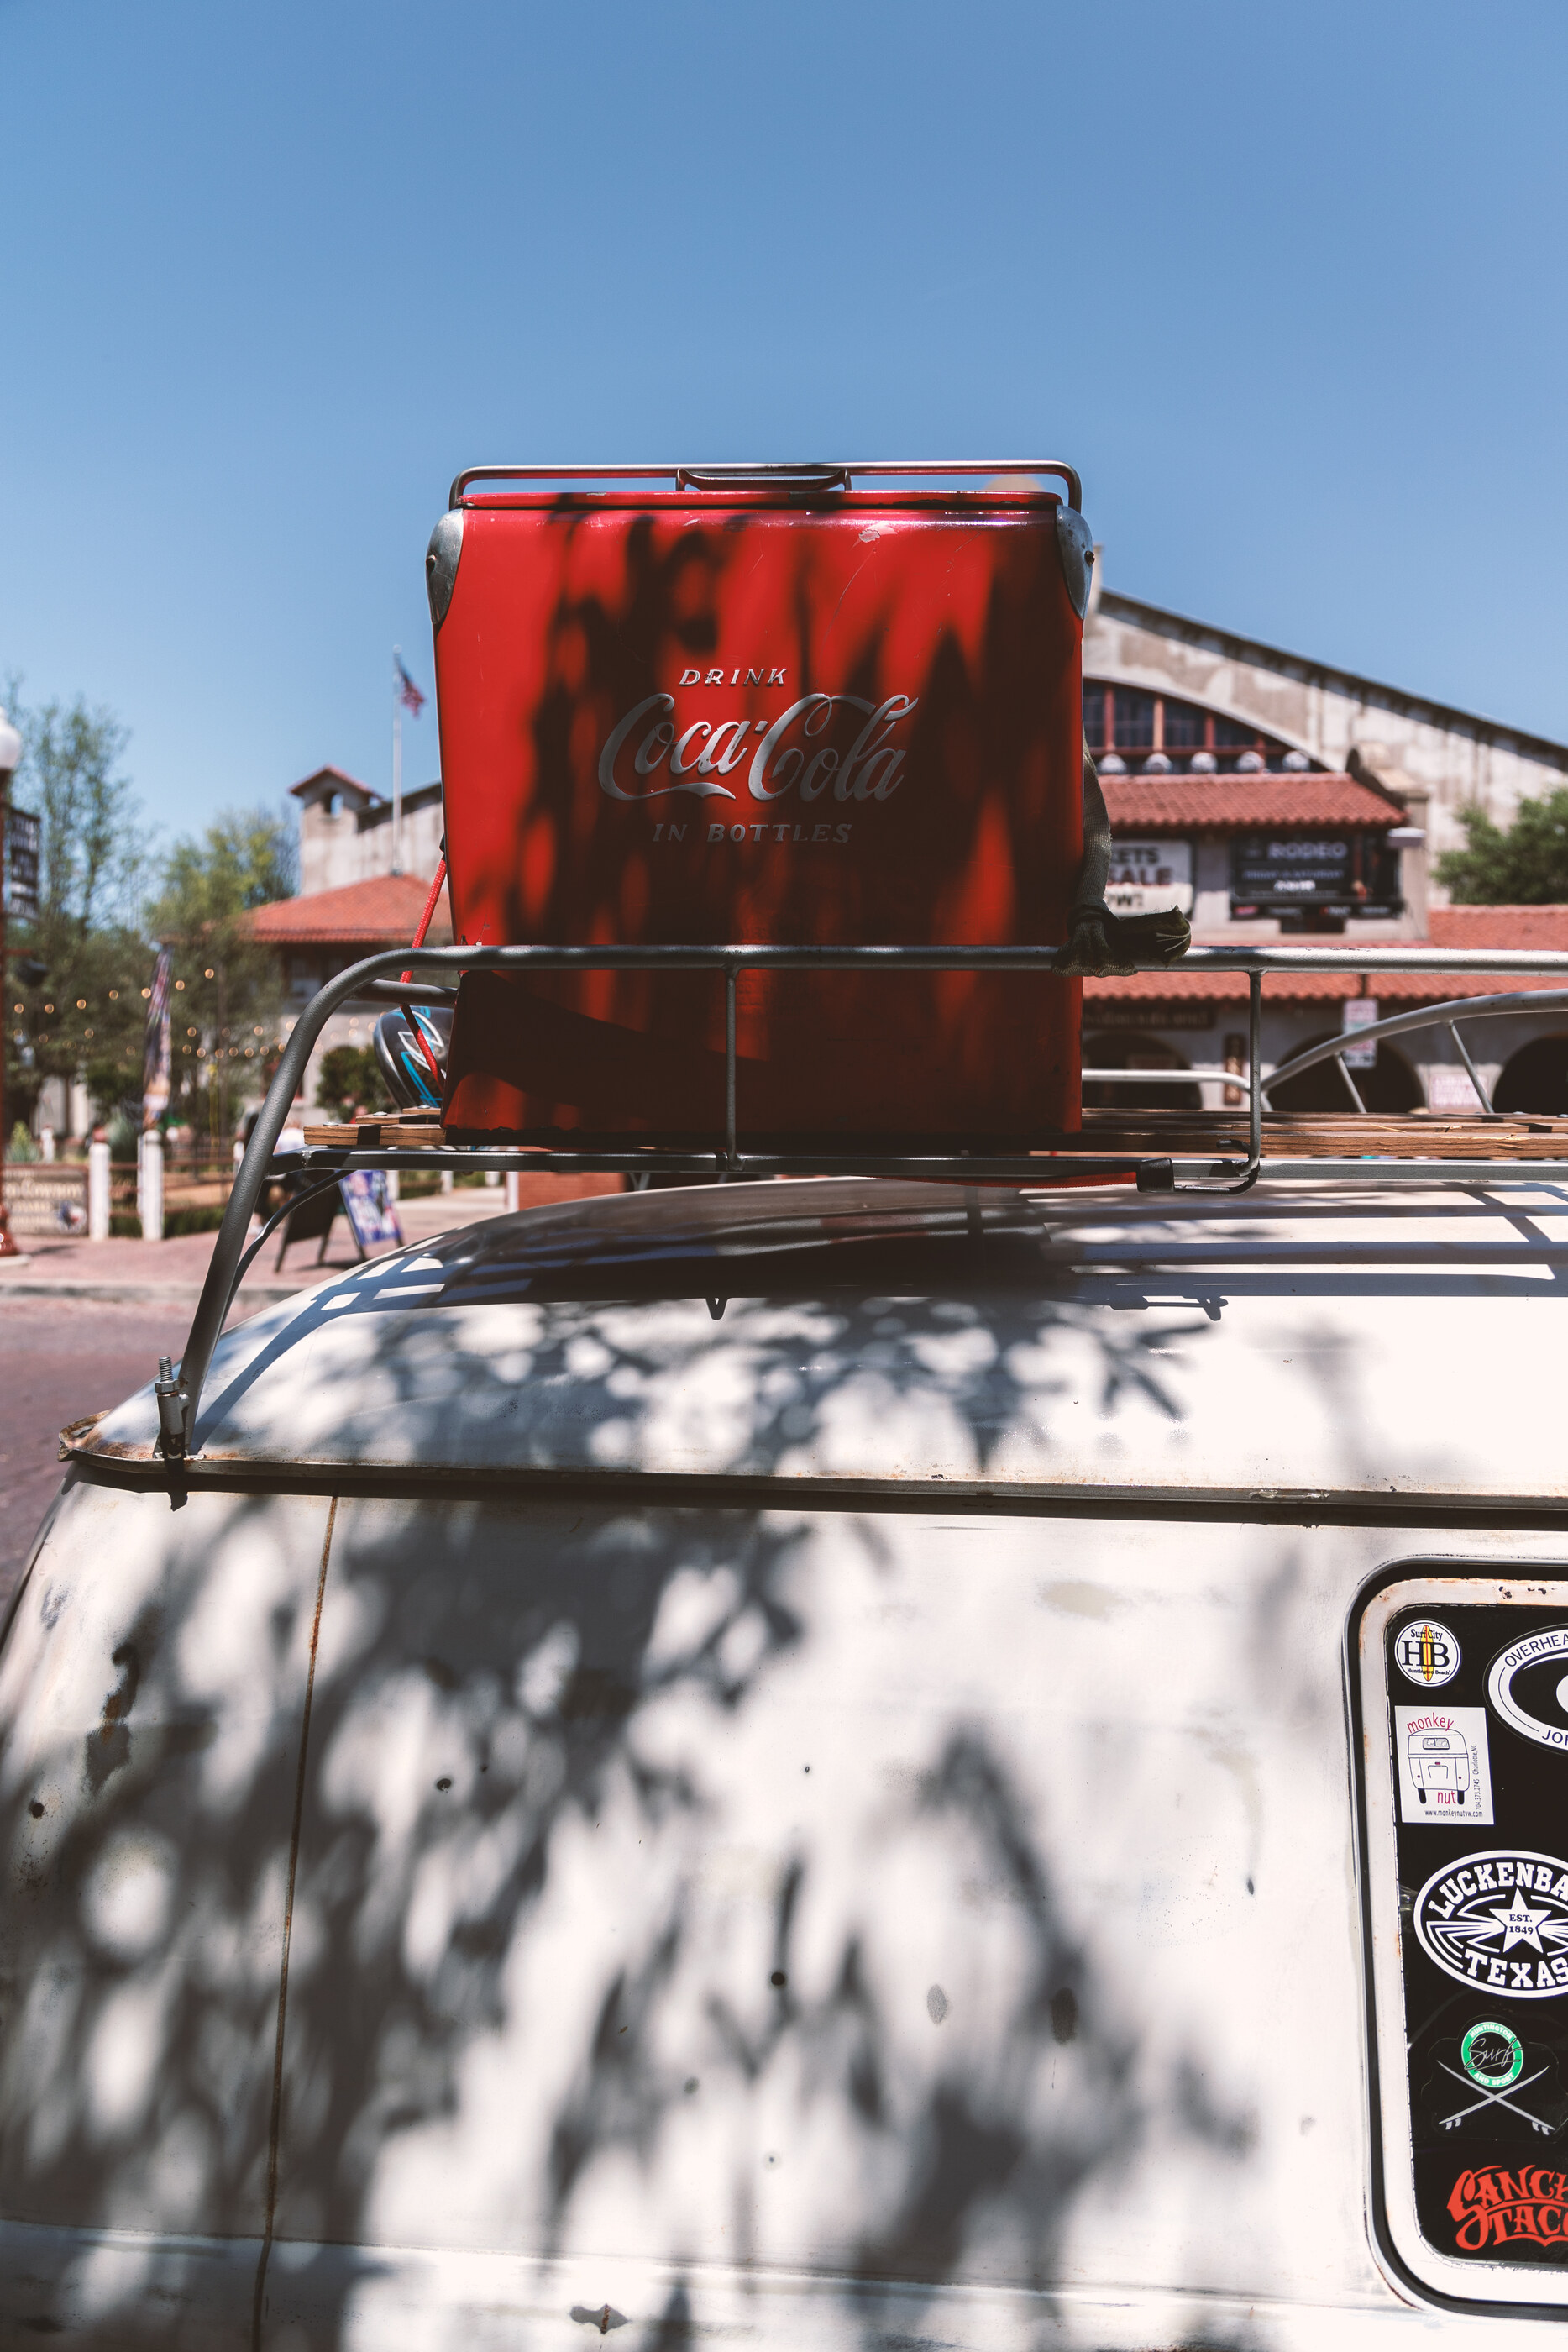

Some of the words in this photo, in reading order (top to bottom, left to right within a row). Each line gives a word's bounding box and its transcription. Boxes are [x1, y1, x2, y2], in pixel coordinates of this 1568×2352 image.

[679, 668, 787, 686] DRINK
[598, 692, 919, 802] Coca-Cola
[653, 823, 688, 843] IN
[707, 823, 852, 843] BOTTLES
[1267, 841, 1348, 859] RODEO
[1411, 1629, 1427, 1638] Surf
[1428, 1630, 1443, 1641] City
[1401, 1640, 1450, 1667] HB
[1407, 1712, 1454, 1733] monkey
[1437, 1790, 1457, 1804] nut
[1424, 1809, 1483, 1818] www.monkeynutvw.com
[1509, 1914, 1533, 1923] EST.
[1509, 1926, 1534, 1935] 1849
[1465, 1949, 1568, 1988] TEXAS
[1469, 2024, 1513, 2040] HUNTINGTON
[1464, 2037, 1523, 2071] Surf
[1474, 2072, 1489, 2085] AND
[1492, 2071, 1514, 2086] SPORT
